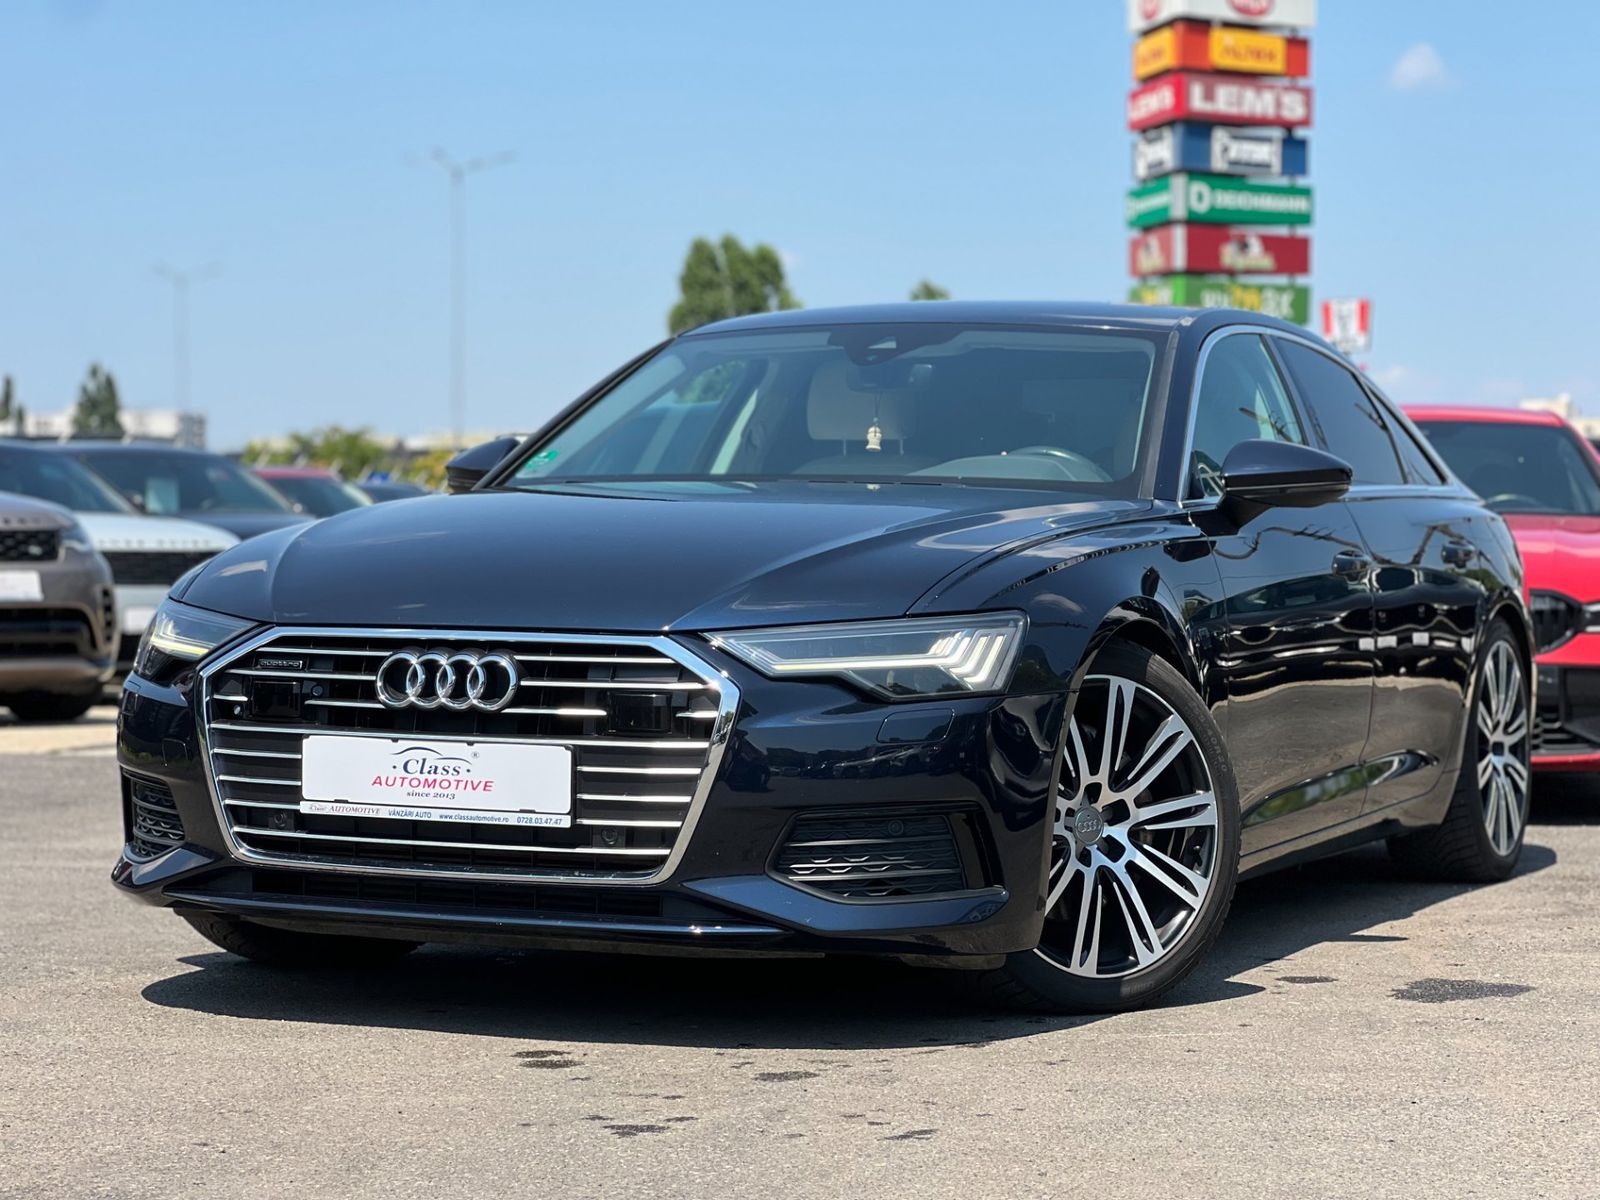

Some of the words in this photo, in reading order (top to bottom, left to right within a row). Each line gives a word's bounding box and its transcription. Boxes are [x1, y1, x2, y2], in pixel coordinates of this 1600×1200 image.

[1189, 82, 1307, 121] LEM'S
[260, 660, 299, 668] quattro
[402, 758, 461, 777] Class
[371, 775, 495, 792] AUTOMOTIVE
[406, 790, 431, 798] since
[433, 792, 456, 800] 2013
[329, 805, 381, 815] AUTOMOTIVE
[415, 811, 432, 819] AUTO
[439, 813, 509, 823] www.classautomotive.ro
[516, 816, 563, 825] 0728.03.47.47
